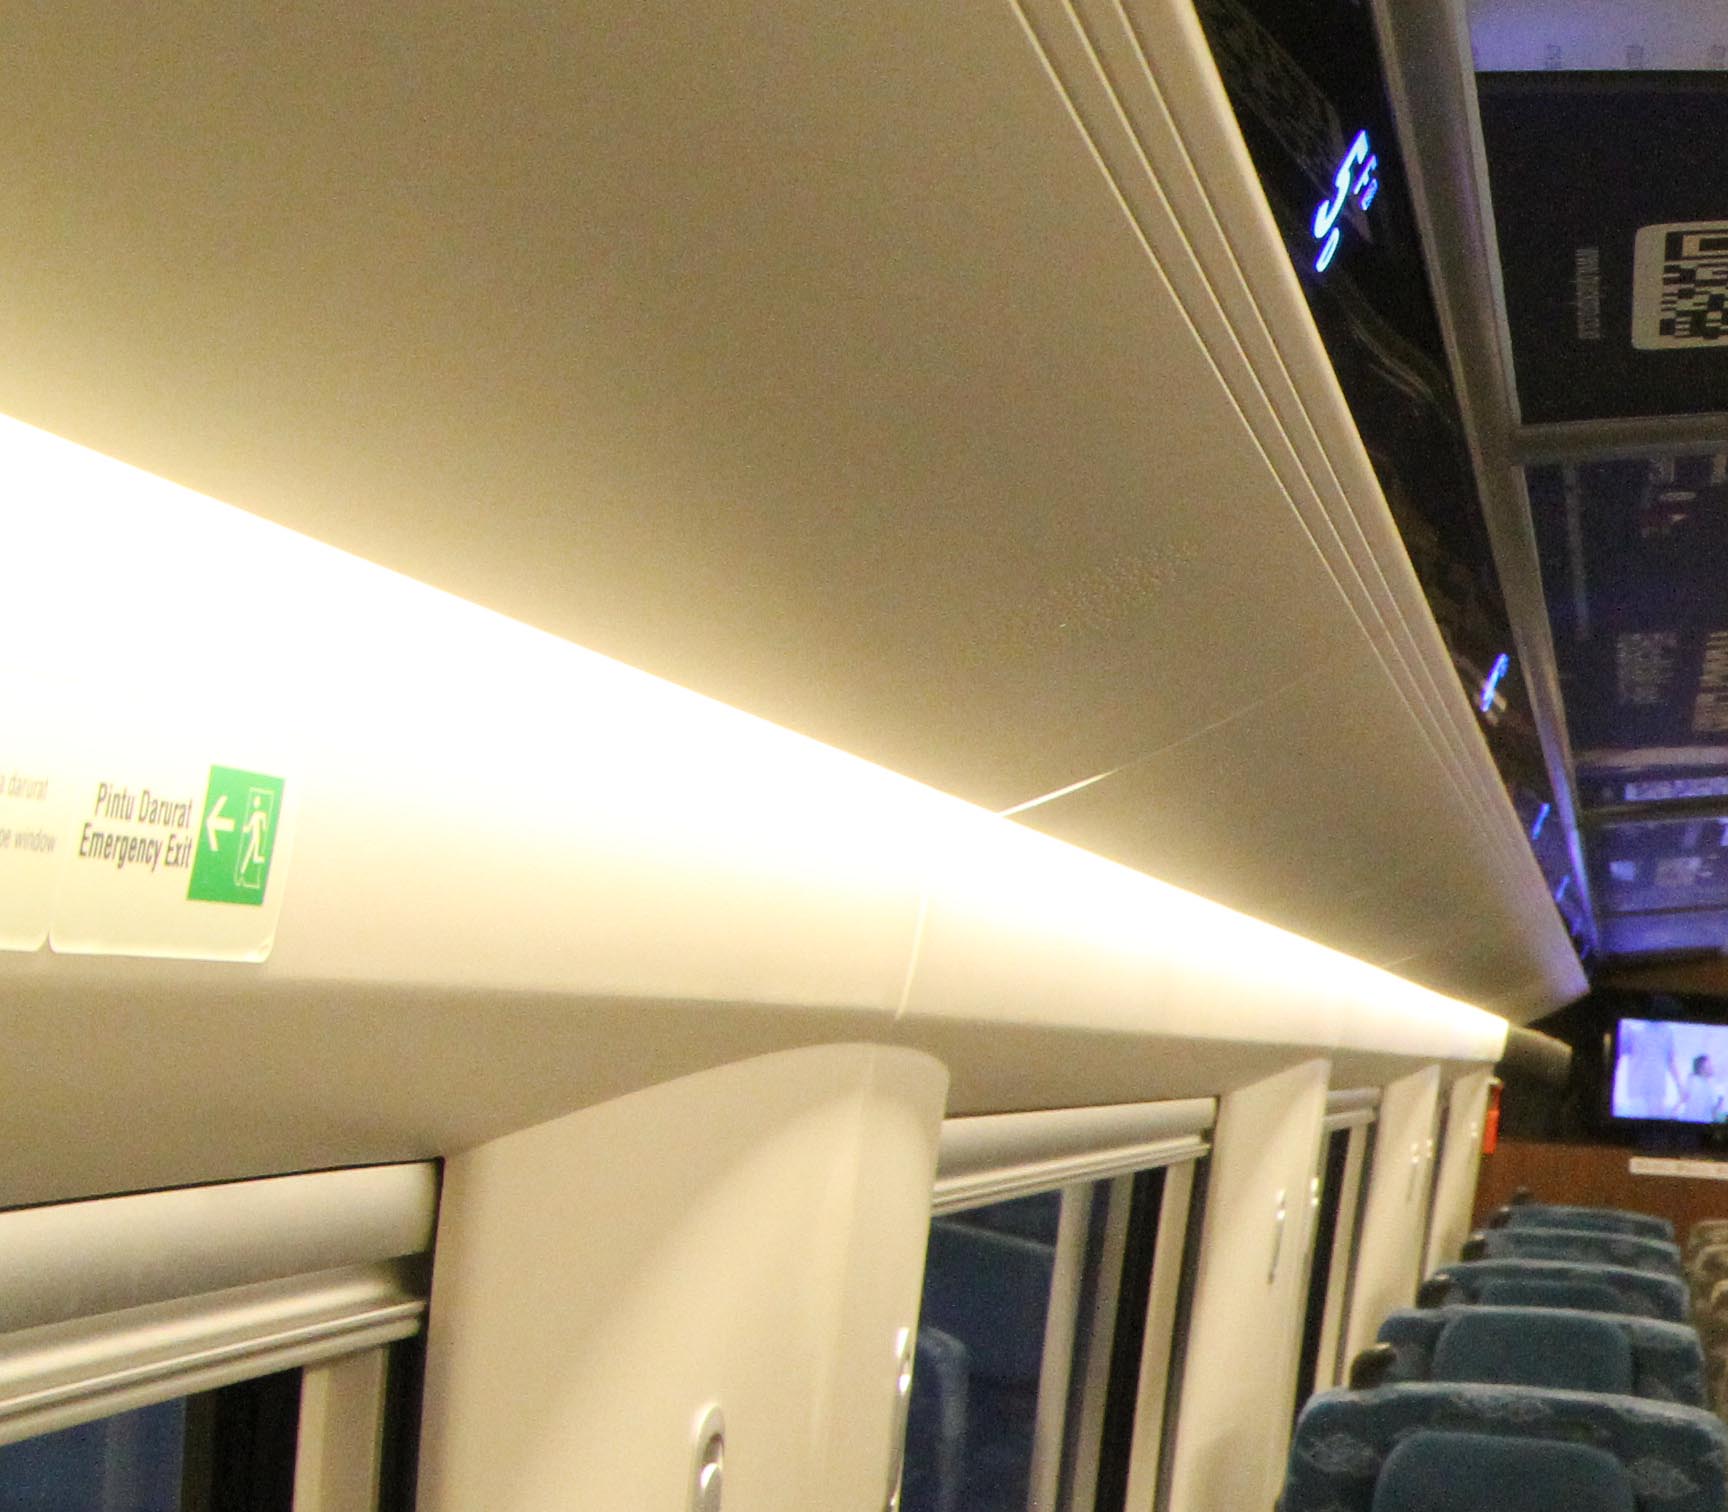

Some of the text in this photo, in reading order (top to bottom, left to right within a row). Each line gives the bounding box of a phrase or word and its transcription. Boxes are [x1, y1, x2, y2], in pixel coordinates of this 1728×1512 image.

[95, 783, 192, 829] Pintu Darurat
[79, 822, 192, 873] Emergency Exit
